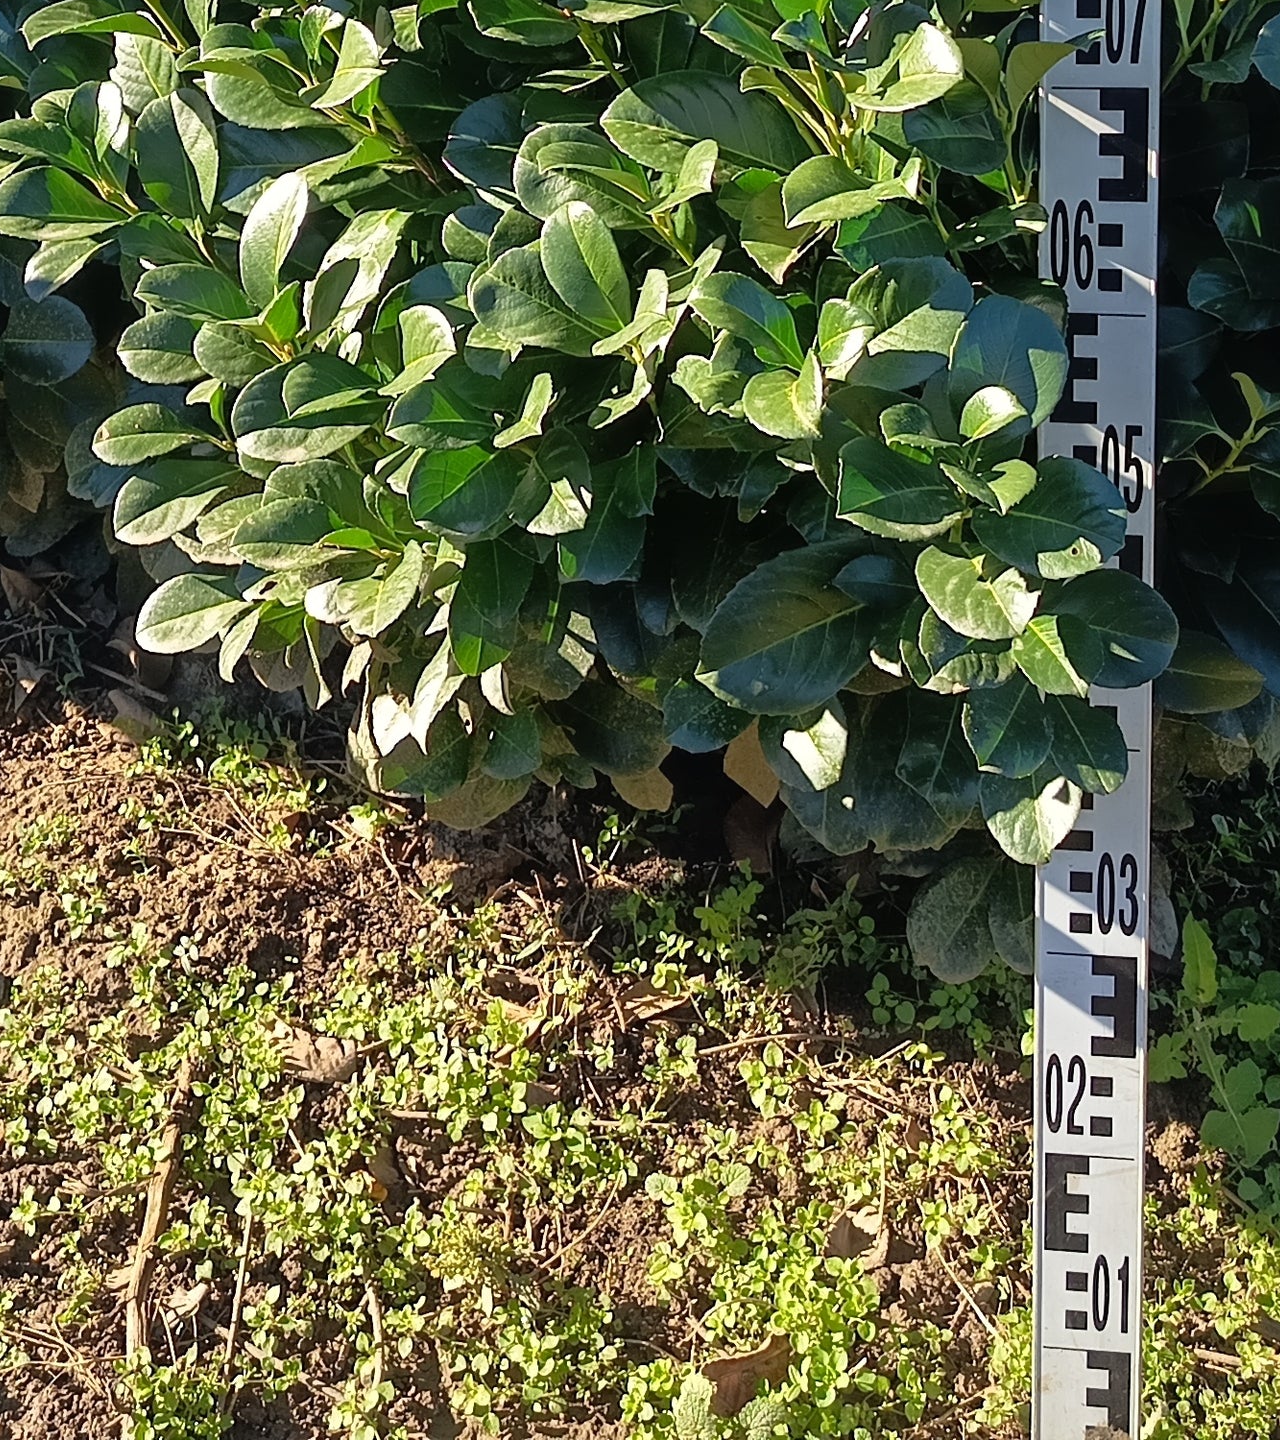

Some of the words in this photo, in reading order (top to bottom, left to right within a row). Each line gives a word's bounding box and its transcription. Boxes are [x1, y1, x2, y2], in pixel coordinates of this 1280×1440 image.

[1051, 199, 1094, 290] 06
[1096, 853, 1138, 937] 03
[1046, 1053, 1084, 1137] 02
[1093, 1256, 1129, 1334] 01
